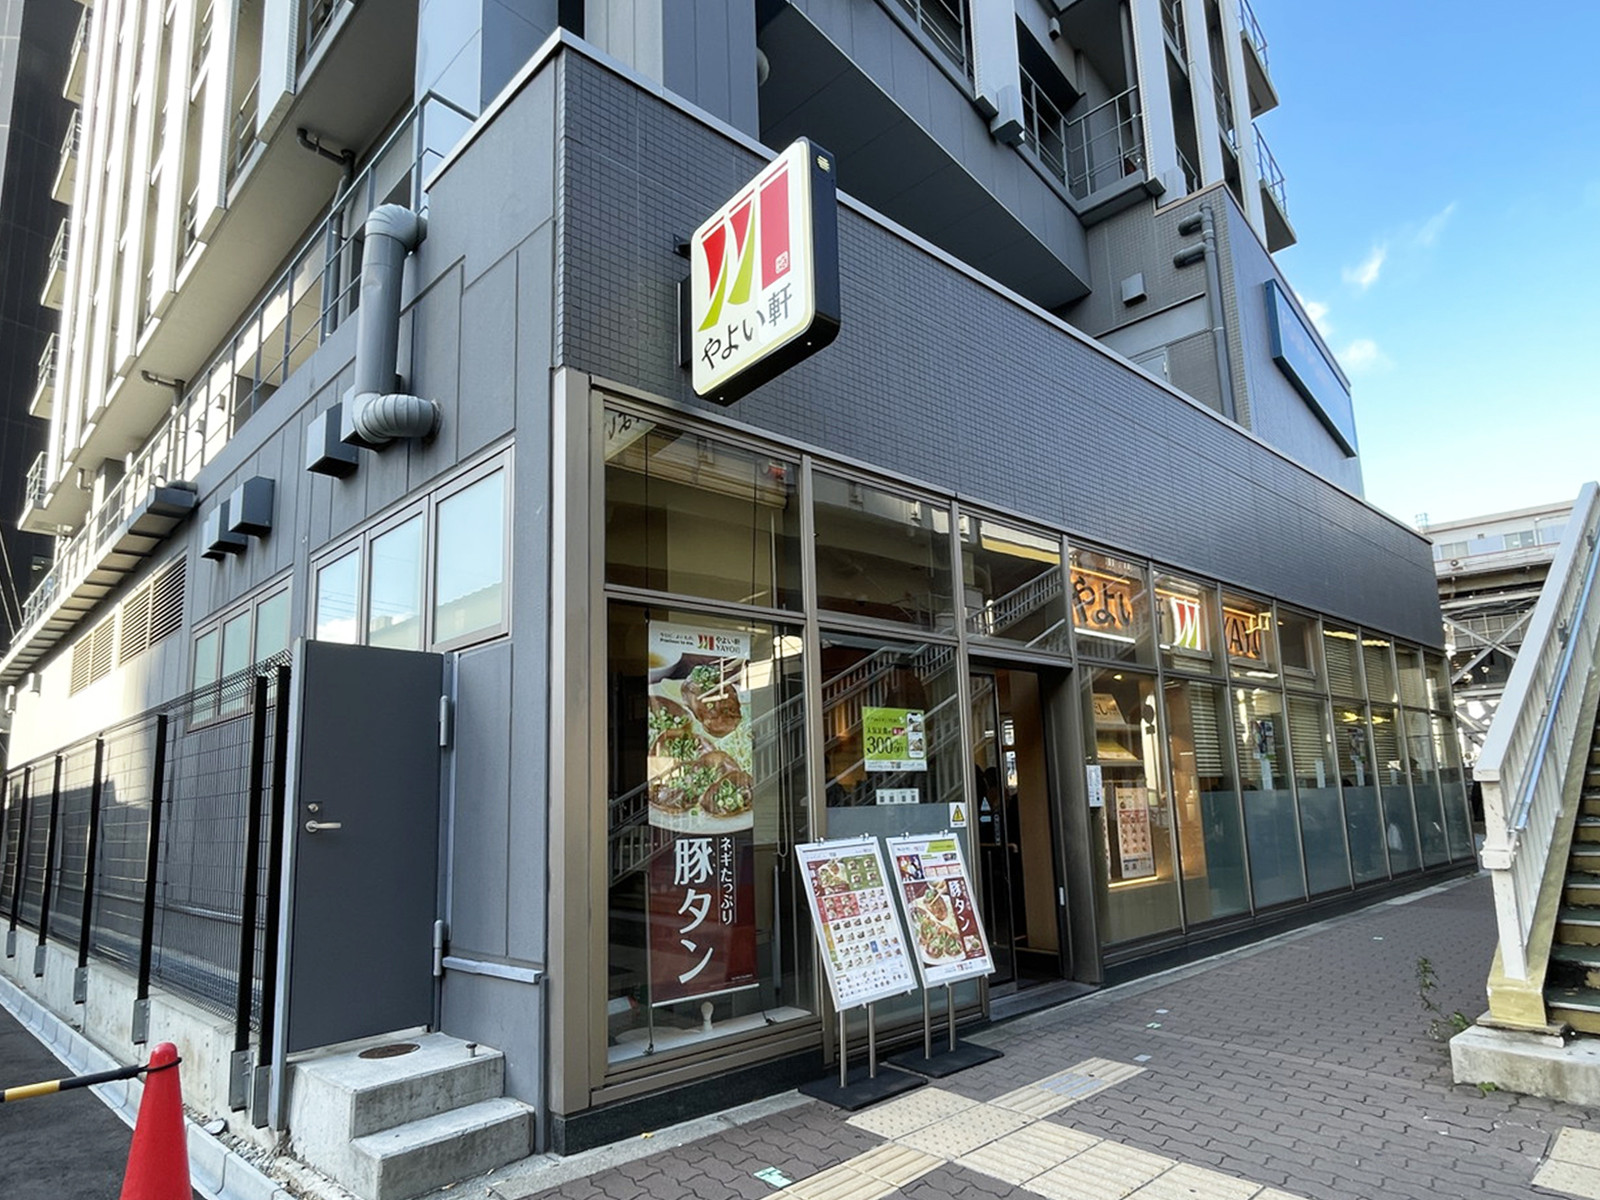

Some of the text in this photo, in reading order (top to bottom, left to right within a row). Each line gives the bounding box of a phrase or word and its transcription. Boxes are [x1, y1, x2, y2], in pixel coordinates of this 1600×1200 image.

[701, 283, 792, 370] やよい軒
[674, 837, 714, 984] 豚タン
[720, 837, 734, 925] ネギたっぷり
